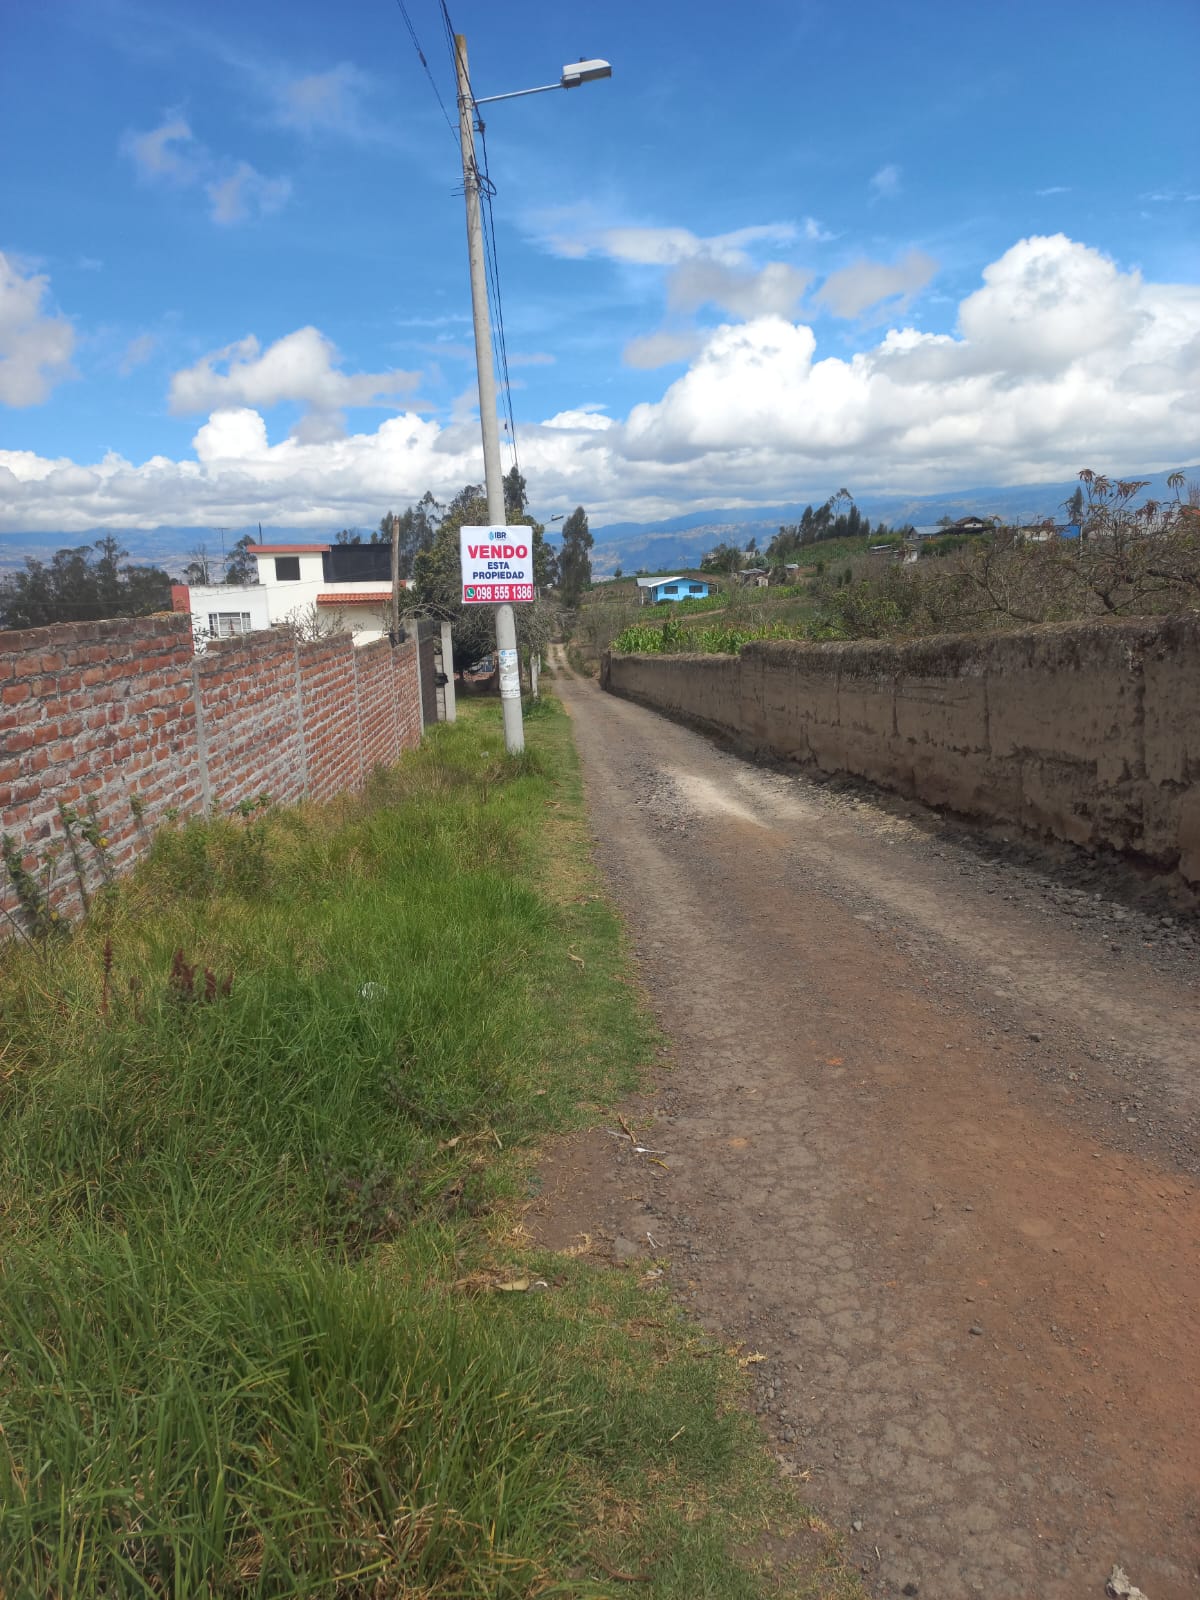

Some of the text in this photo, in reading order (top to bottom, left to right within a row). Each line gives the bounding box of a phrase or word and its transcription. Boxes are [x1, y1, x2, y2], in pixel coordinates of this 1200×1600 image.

[467, 545, 528, 558] VENDO
[476, 586, 532, 599] 098 555 1386
